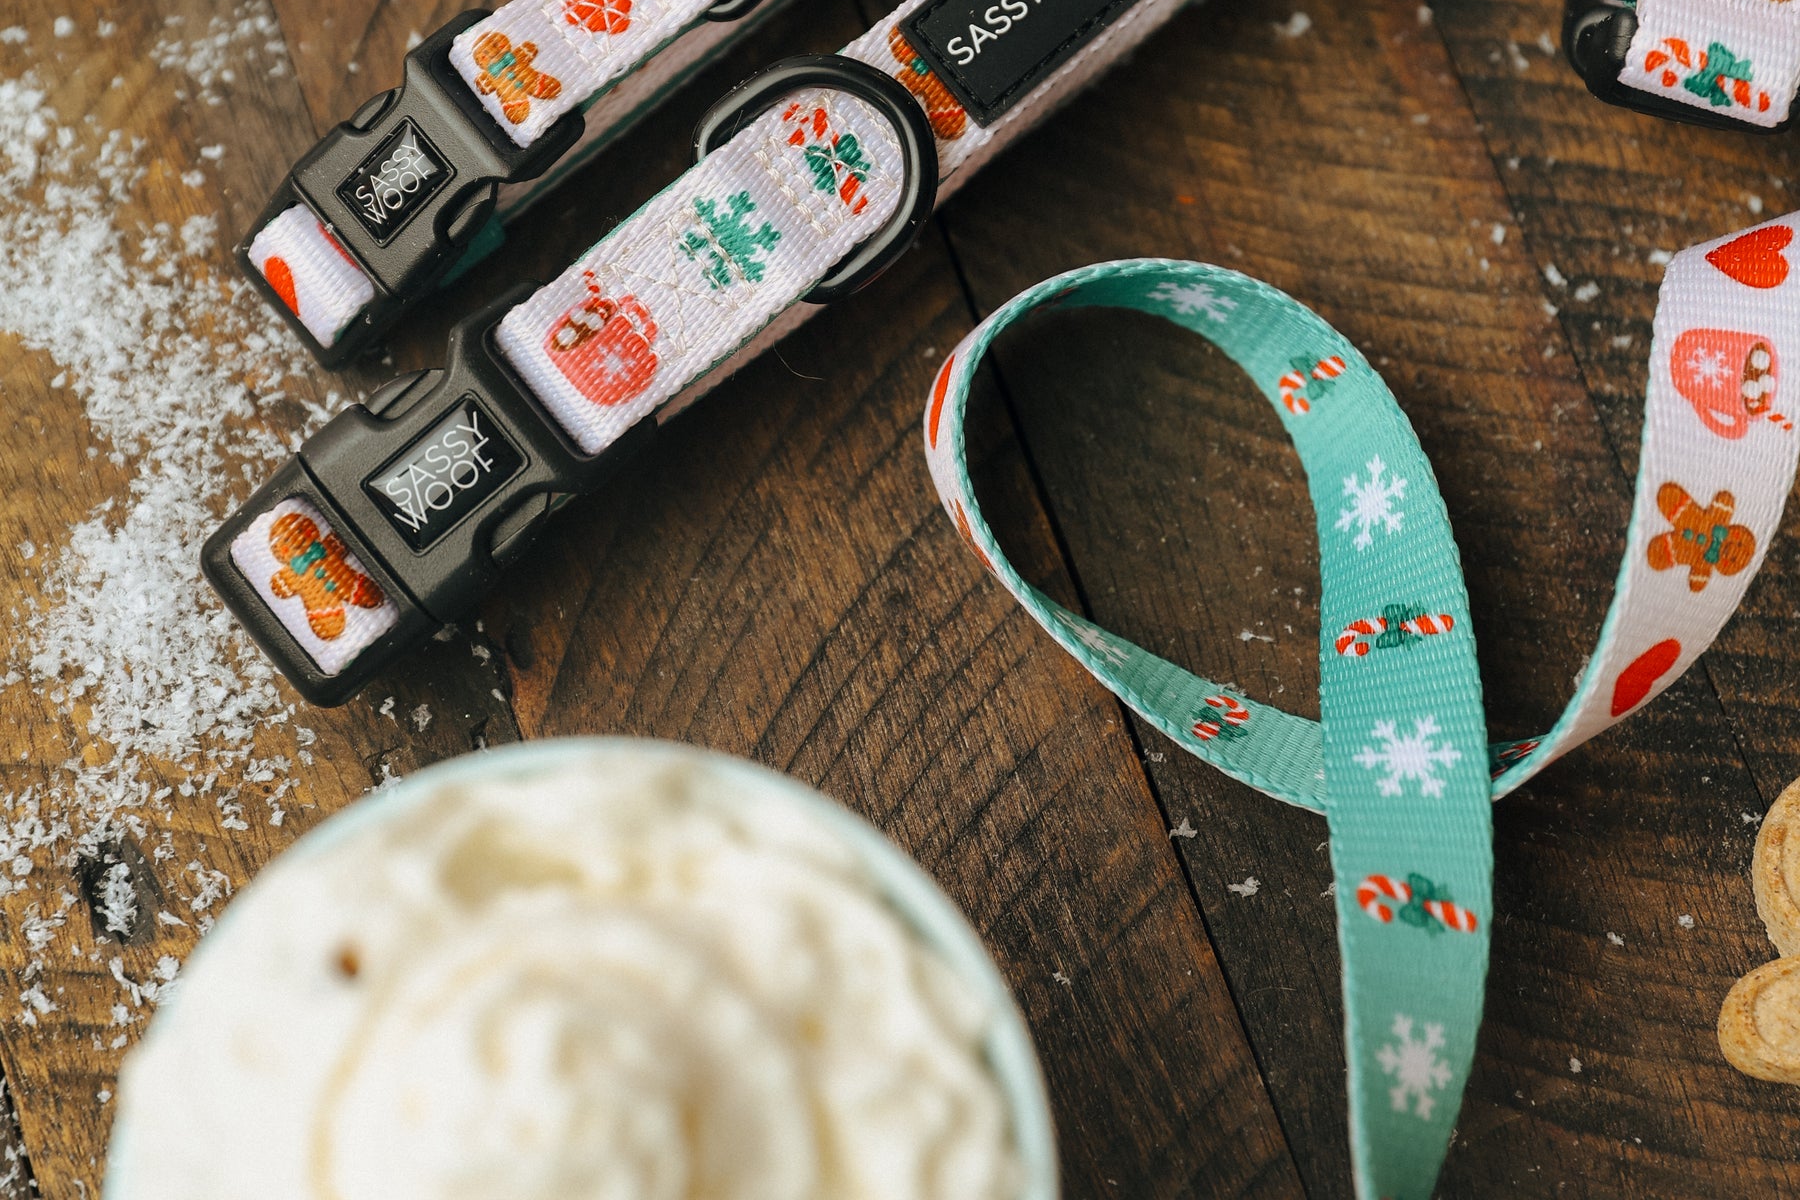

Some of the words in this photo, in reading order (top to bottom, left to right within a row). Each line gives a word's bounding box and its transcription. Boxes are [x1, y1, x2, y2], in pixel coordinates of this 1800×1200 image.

[355, 134, 421, 208] SASSY
[363, 153, 431, 225] WOOF
[385, 410, 484, 507] SASSY
[393, 436, 494, 531] WOOF
